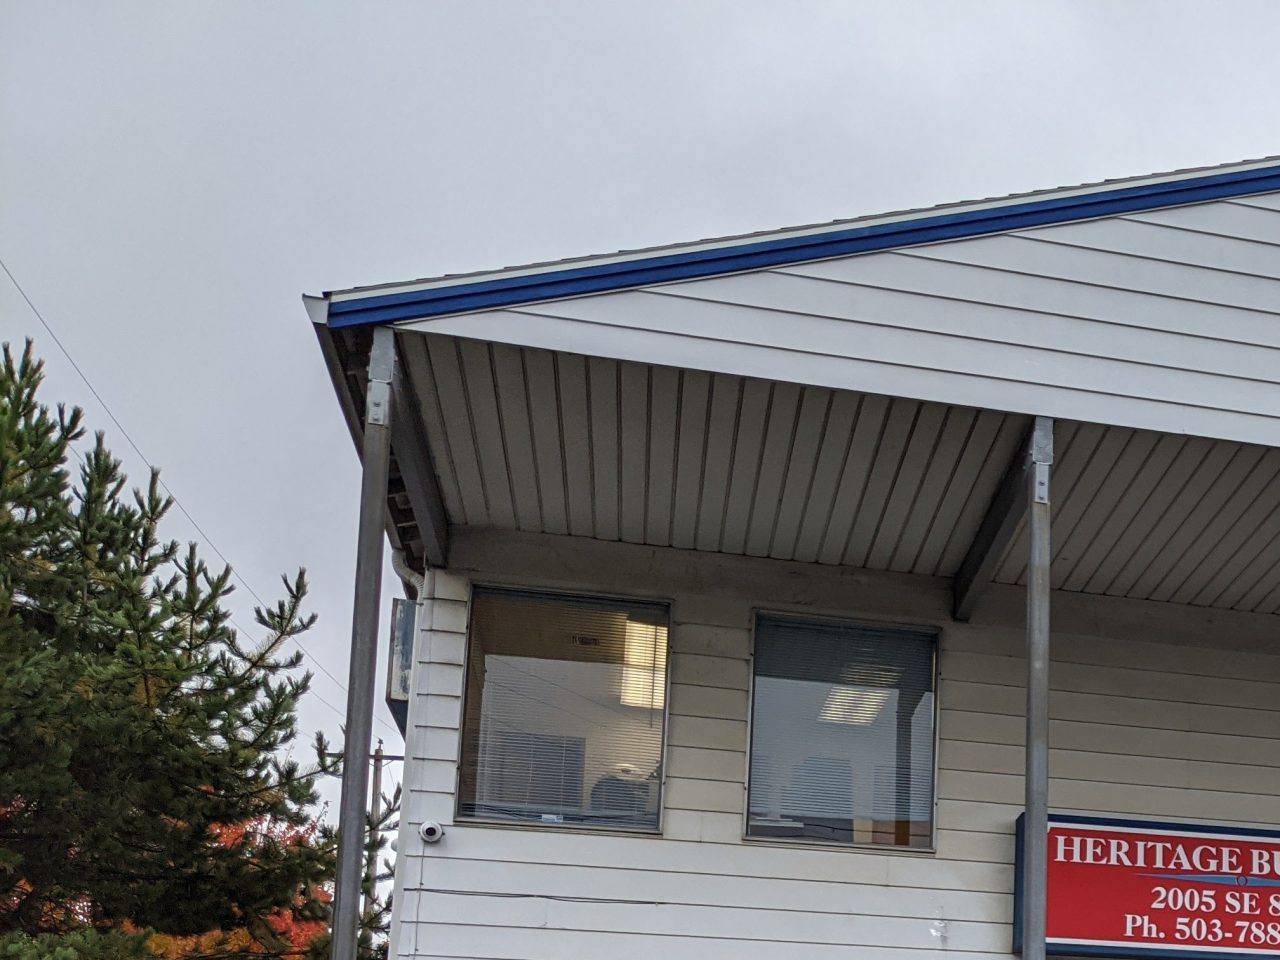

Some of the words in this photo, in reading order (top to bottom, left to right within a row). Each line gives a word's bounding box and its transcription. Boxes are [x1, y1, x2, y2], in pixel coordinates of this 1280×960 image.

[1055, 834, 1242, 876] HERITAGE
[1152, 887, 1215, 912] 2005
[1226, 892, 1260, 914] SE
[1125, 915, 1165, 938] Ph.
